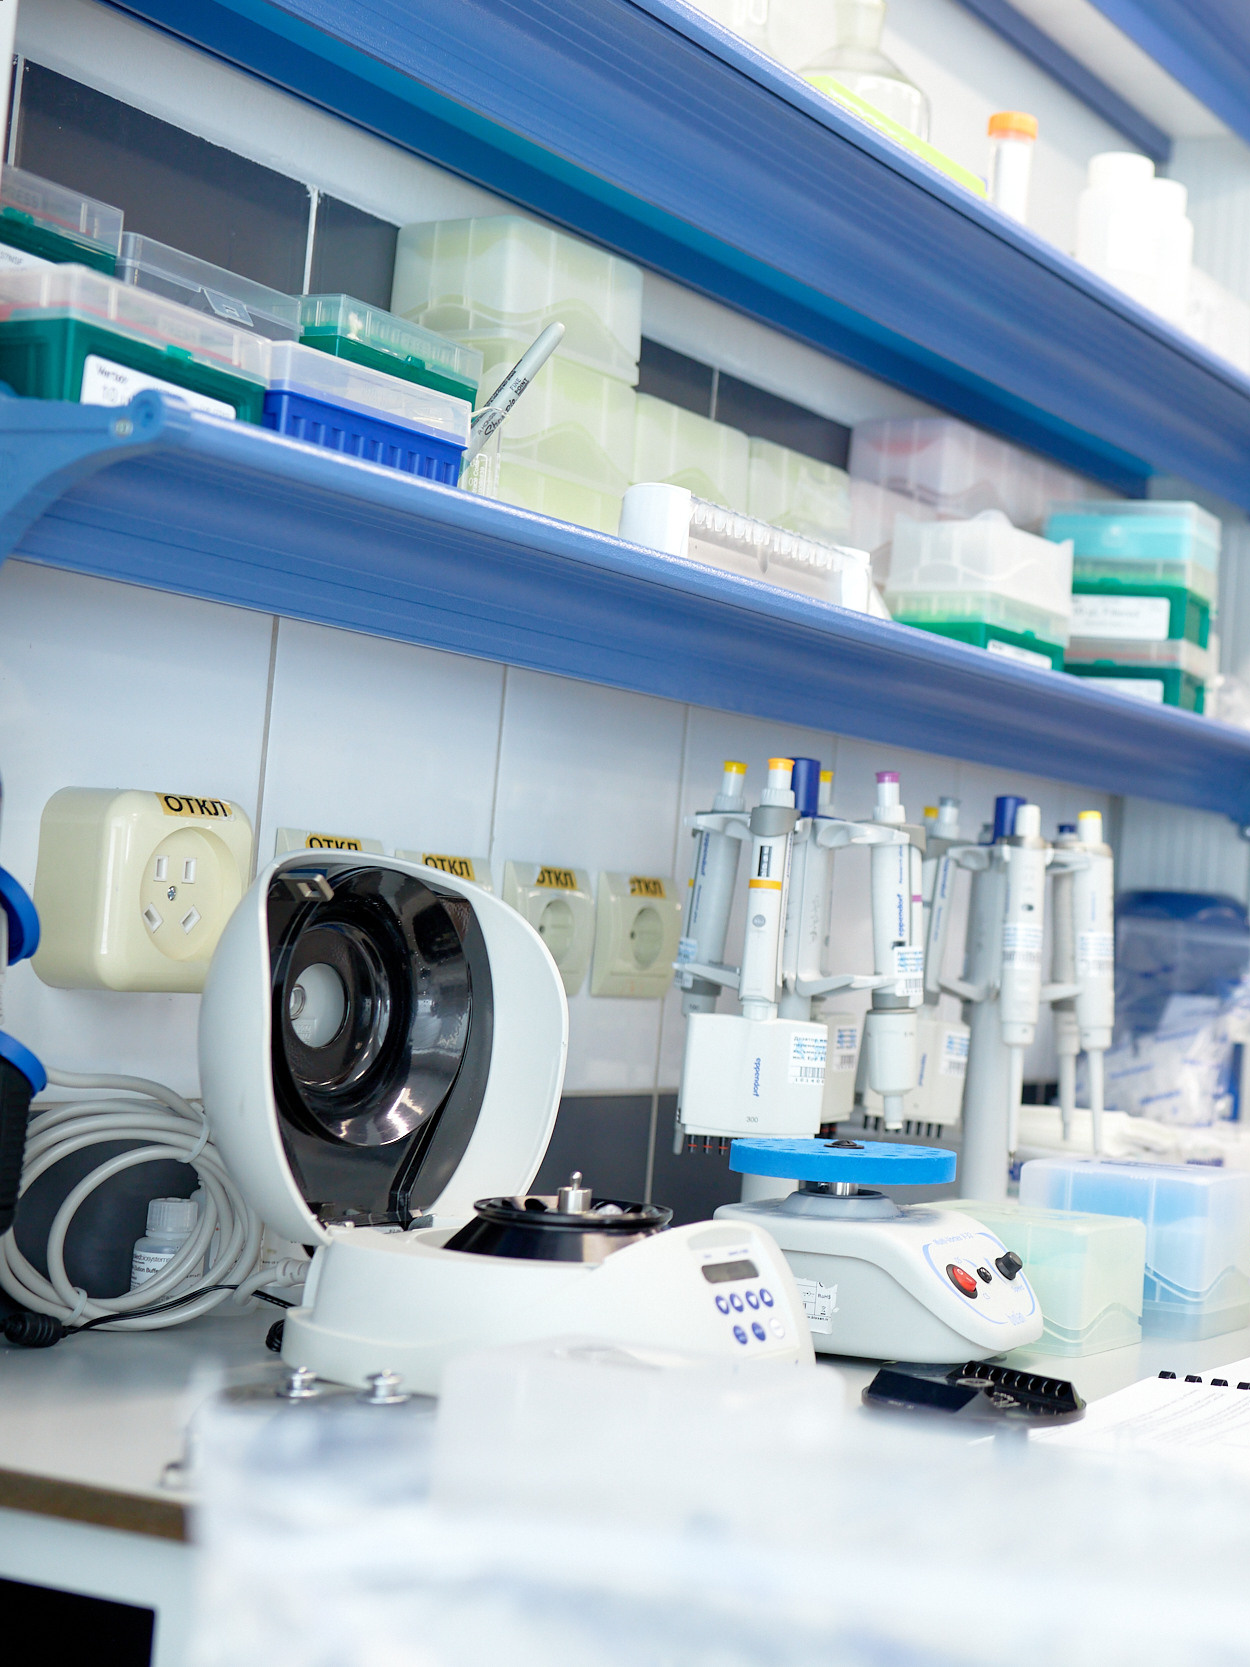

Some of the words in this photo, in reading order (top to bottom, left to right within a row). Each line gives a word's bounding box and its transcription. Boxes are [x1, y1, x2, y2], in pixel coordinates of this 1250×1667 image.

[510, 377, 522, 391] FINE
[514, 377, 530, 396] POINT
[164, 795, 228, 817] ОТКЛ
[753, 1057, 761, 1097] eppendorf
